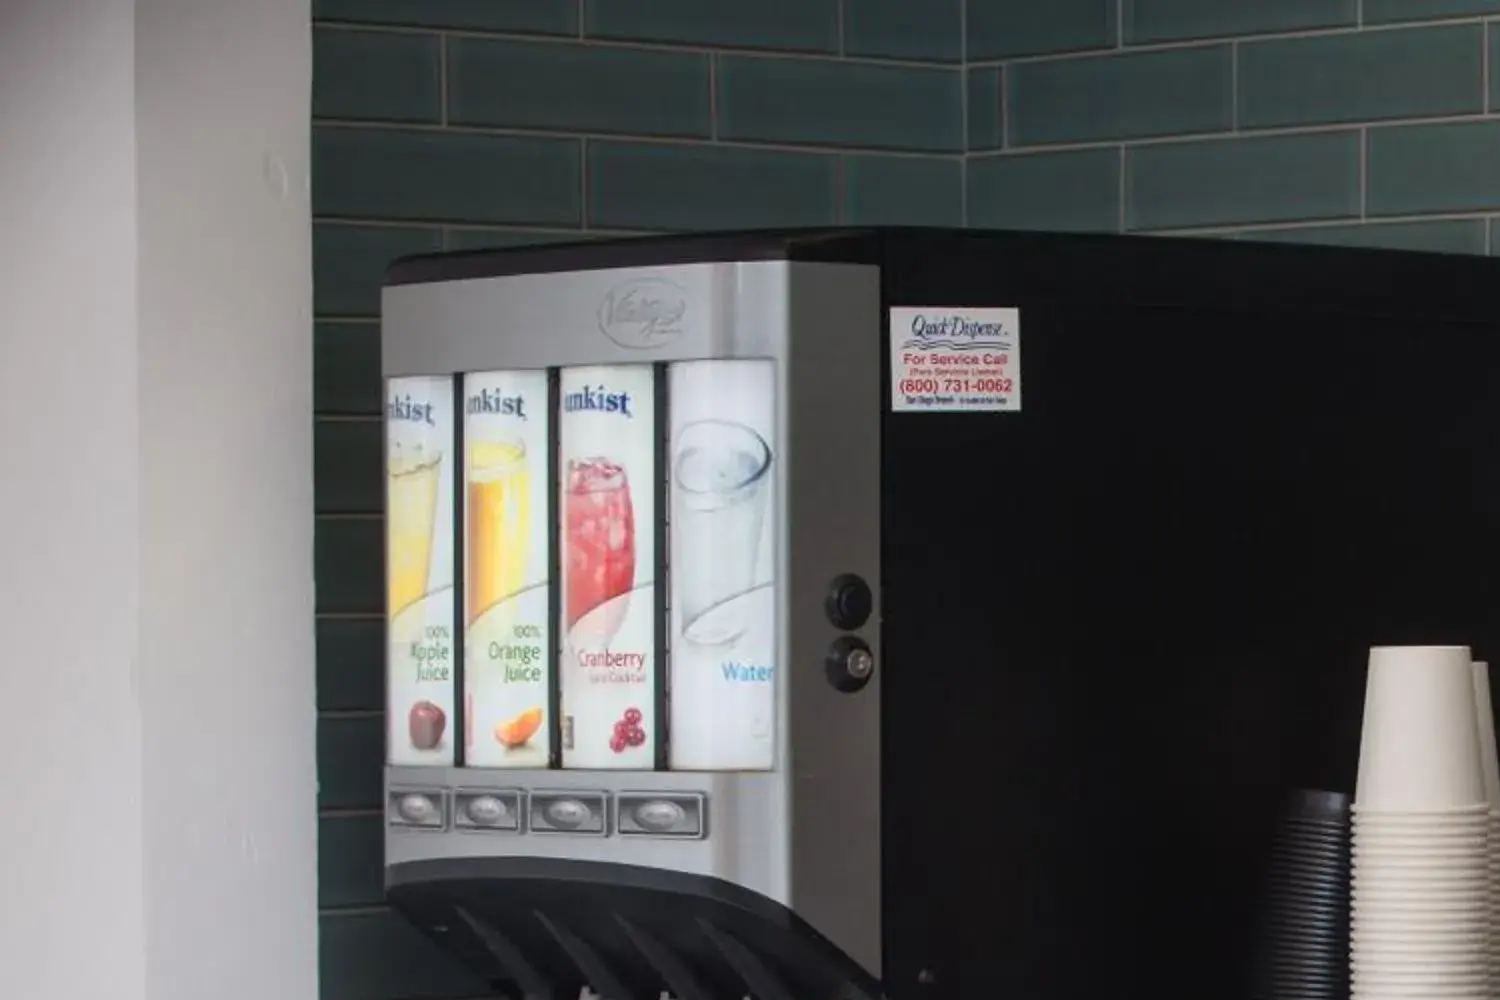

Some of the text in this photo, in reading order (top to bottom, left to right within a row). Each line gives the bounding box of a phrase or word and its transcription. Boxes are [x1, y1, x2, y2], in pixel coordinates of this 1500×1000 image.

[903, 353, 1008, 365] For Service Call
[899, 378, 1014, 395] (800) 731-0062
[410, 640, 450, 663] Apple
[487, 641, 542, 665] Orange
[579, 648, 647, 670] Cranberry
[414, 662, 450, 684] Juice
[502, 664, 542, 684] Juice
[721, 660, 775, 683] Water
